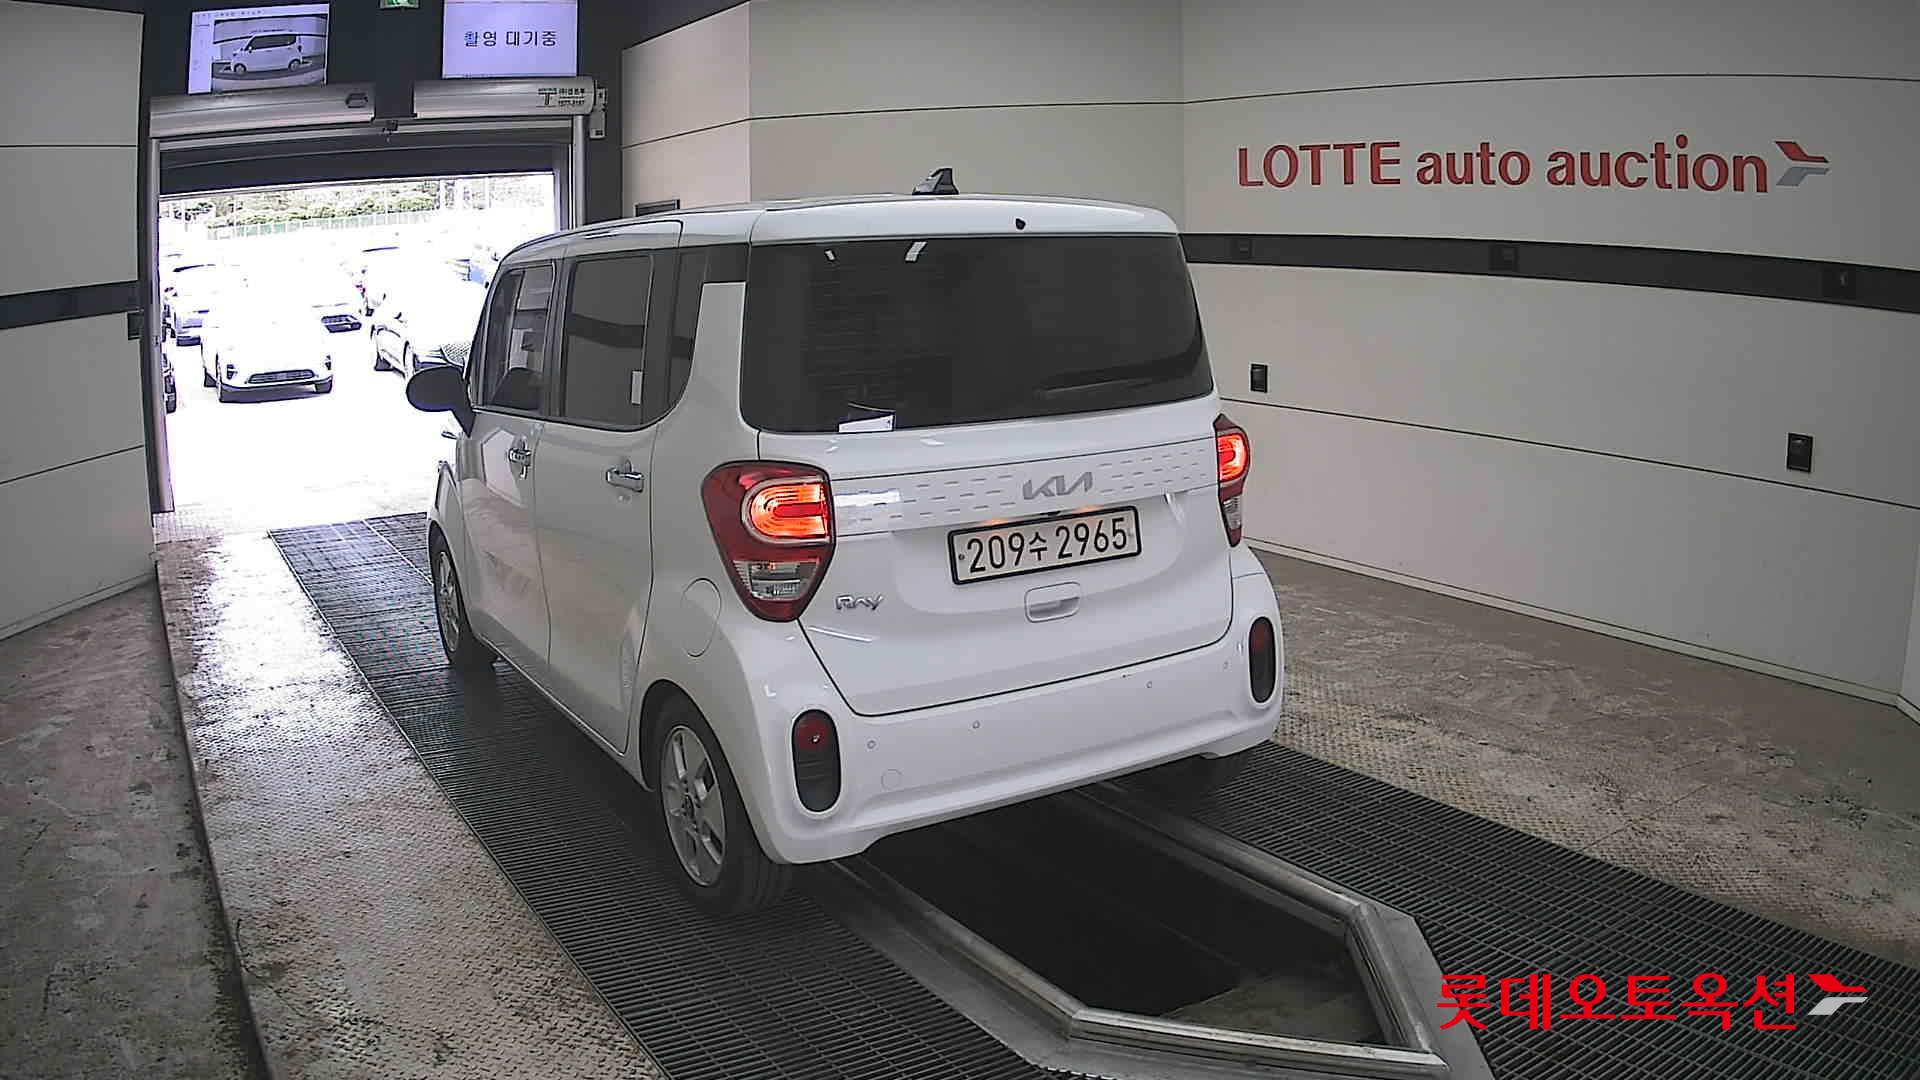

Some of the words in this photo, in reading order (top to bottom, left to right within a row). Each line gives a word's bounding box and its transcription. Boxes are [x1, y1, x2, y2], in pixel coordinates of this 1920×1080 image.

[464, 31, 497, 47] 촬영
[505, 31, 556, 47] 대기중
[1238, 141, 1400, 187] LOTTE
[1416, 141, 1532, 187] auto
[1546, 134, 1769, 193] auction
[1022, 471, 1093, 501] KIA
[966, 531, 1048, 574] 209수
[1055, 516, 1128, 560] 2965
